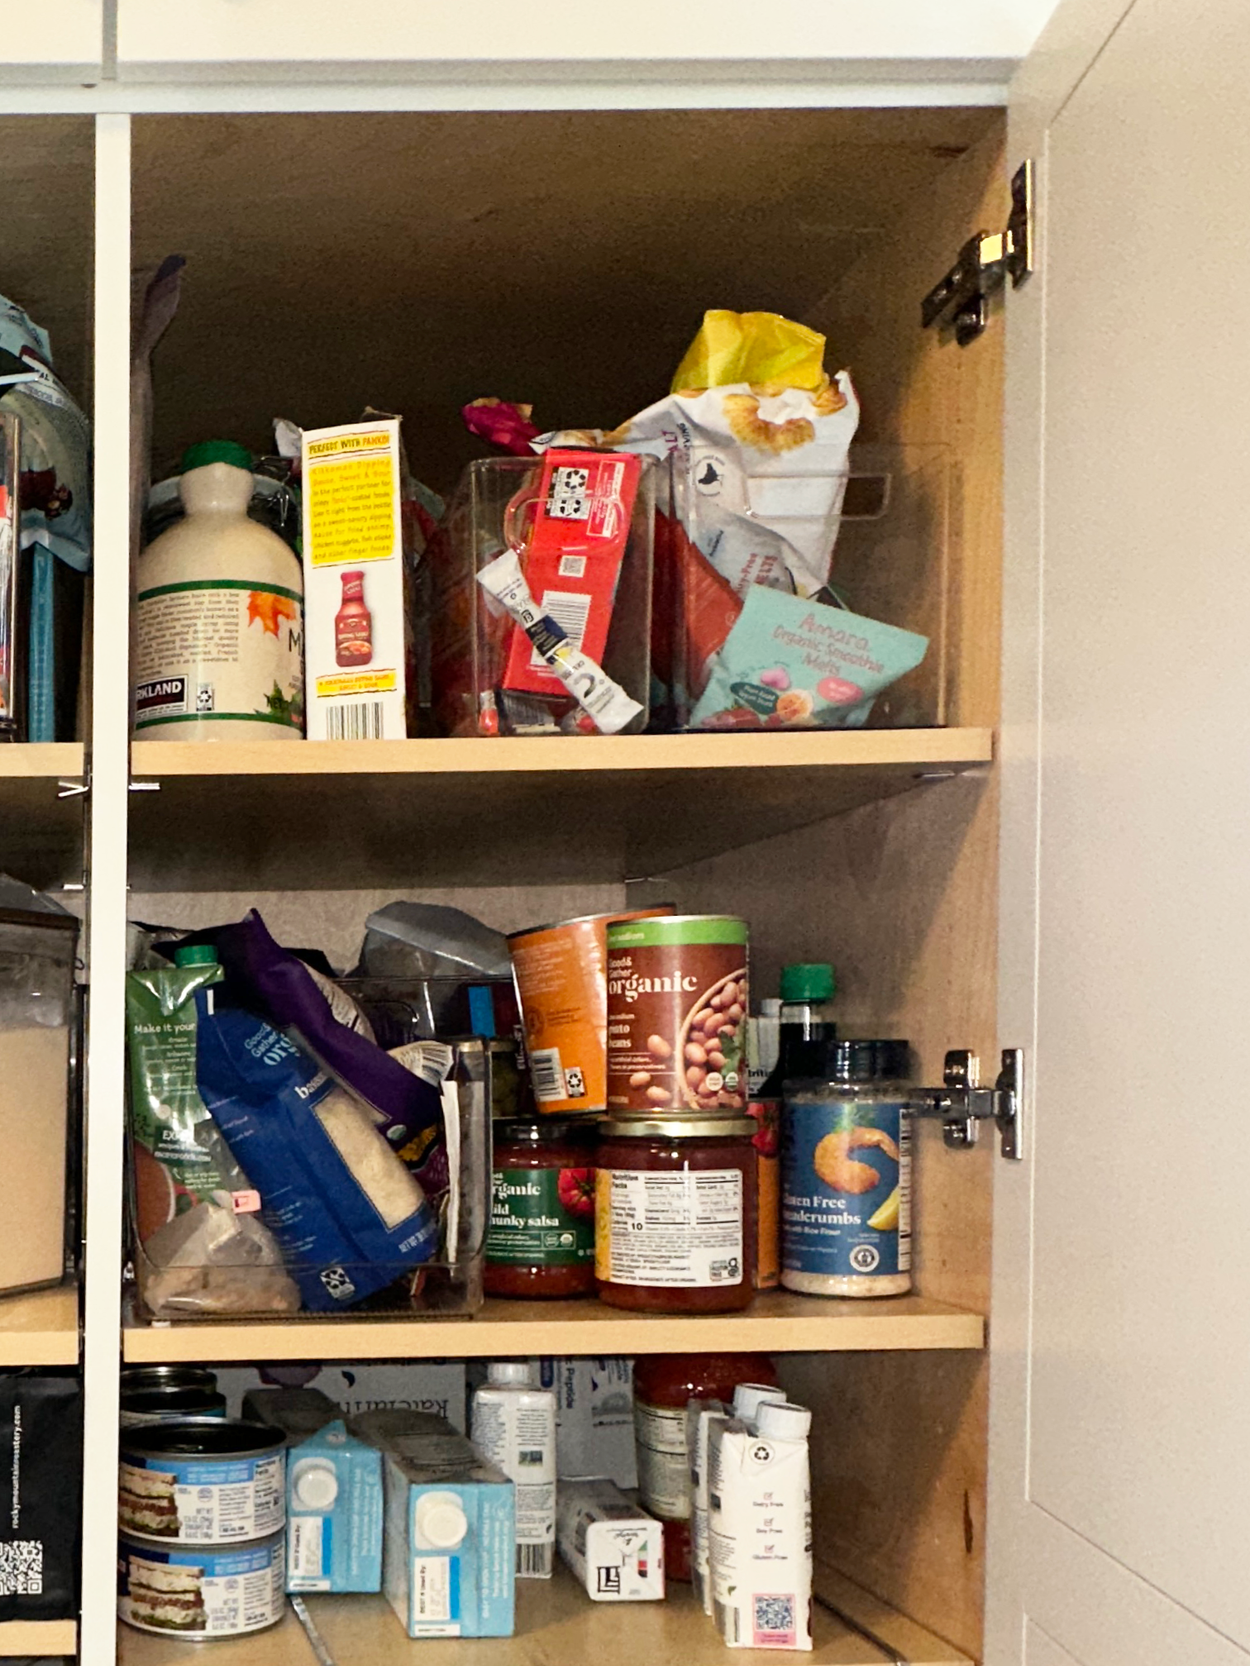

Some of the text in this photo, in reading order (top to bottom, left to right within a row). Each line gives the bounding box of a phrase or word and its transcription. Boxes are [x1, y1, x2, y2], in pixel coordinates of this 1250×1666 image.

[309, 441, 338, 454] PERFECT
[340, 438, 361, 450] WITH
[332, 484, 354, 494] perfect
[347, 505, 361, 513] from
[799, 612, 870, 651] Amara
[771, 625, 884, 675] Organic Smoothie
[803, 651, 842, 677] Melts
[136, 681, 183, 701] RKLAND
[609, 971, 698, 1003] organic
[134, 1023, 162, 1034] Make
[163, 1023, 172, 1032] it
[251, 1032, 279, 1059] Gather
[612, 1173, 639, 1182] Nutrition
[492, 1182, 542, 1200] rganic
[493, 1203, 510, 1215] ild
[813, 1195, 847, 1209] Free
[492, 1215, 560, 1229] unky salsa
[784, 1210, 862, 1225] eadcrumbs
[631, 1223, 644, 1231] 10
[803, 1226, 842, 1236] Rice Flour
[567, 1368, 576, 1410] Peptide
[11, 1405, 22, 1529] rockymountainroastery.com
